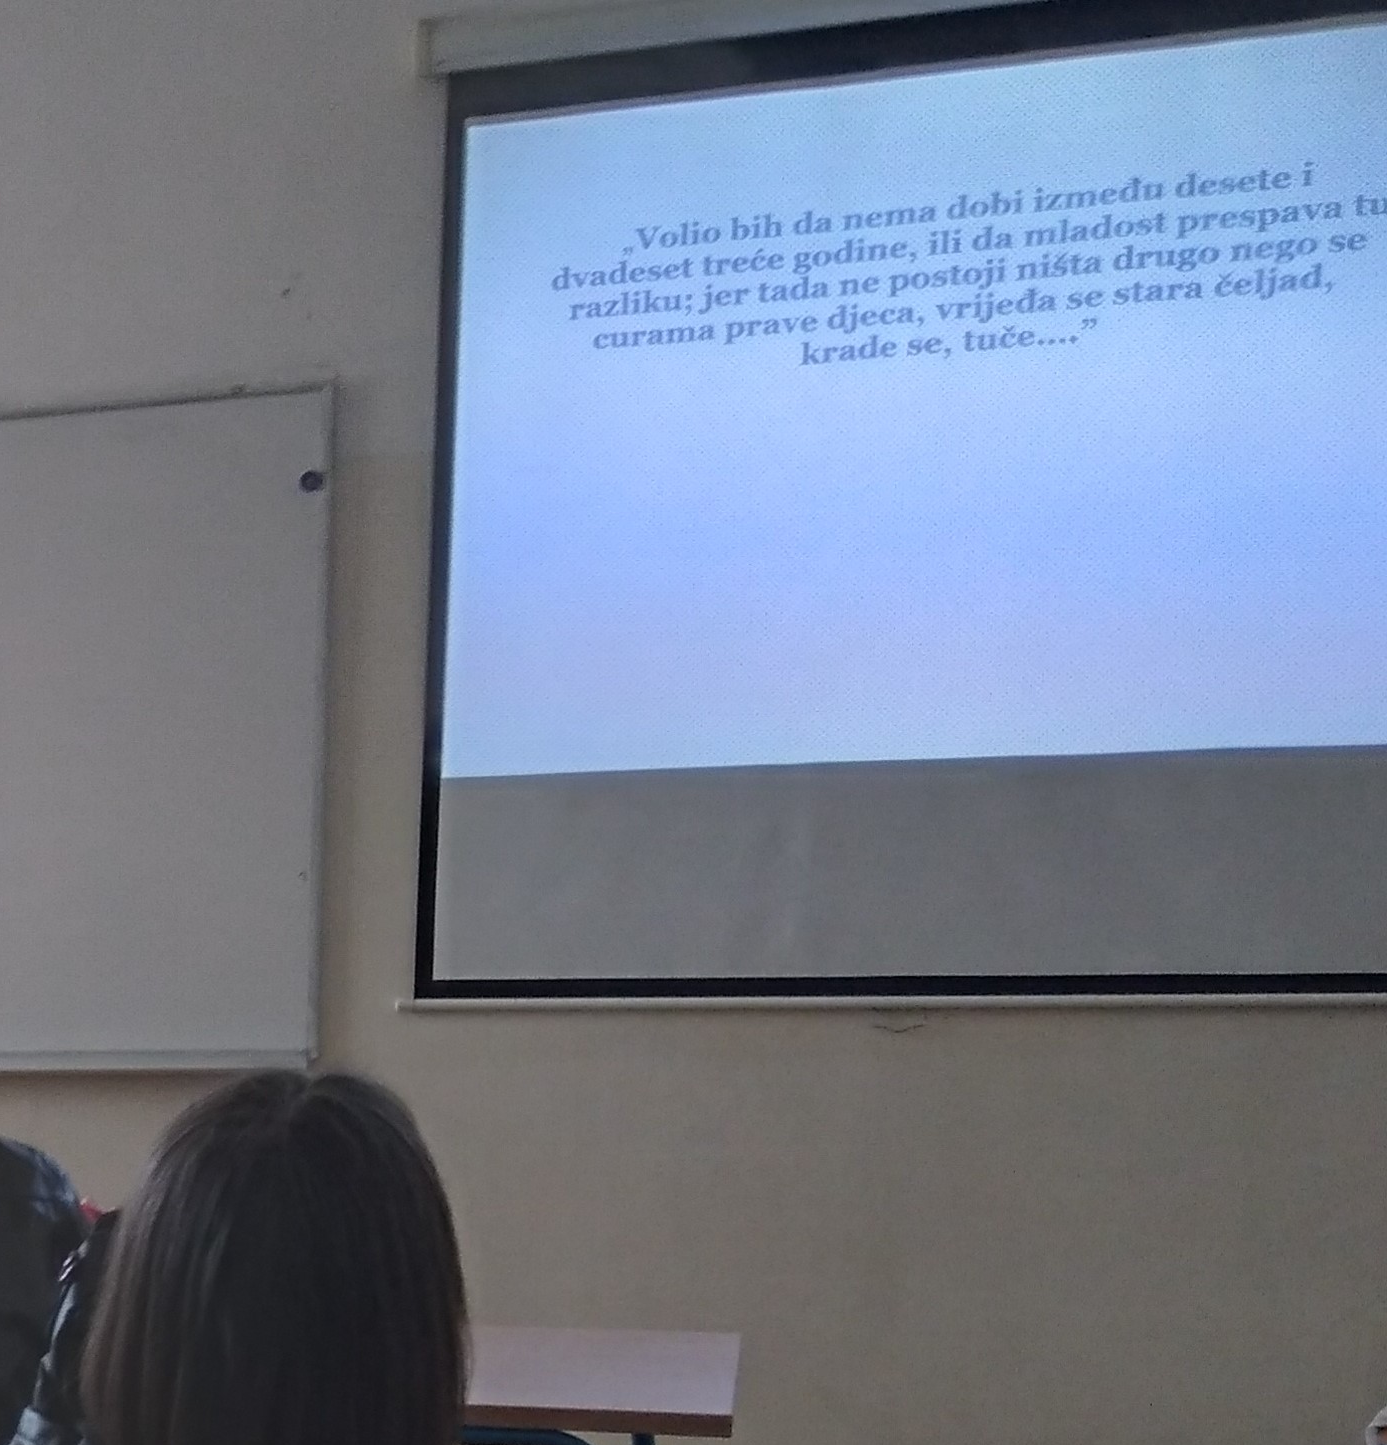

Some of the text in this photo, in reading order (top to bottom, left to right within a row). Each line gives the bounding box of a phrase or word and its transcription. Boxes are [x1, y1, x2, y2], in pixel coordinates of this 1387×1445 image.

[731, 212, 782, 241] bih
[793, 211, 832, 237] da
[843, 203, 936, 231] nema
[947, 189, 1022, 220] dobi
[1175, 167, 1291, 199] desete
[1302, 162, 1314, 187] i
[551, 258, 692, 292] dvadeset
[703, 248, 785, 278] treće
[793, 239, 918, 275] godine,
[928, 230, 962, 257] ili
[972, 225, 1013, 251] da
[1025, 212, 1167, 248] mladost
[1177, 200, 1342, 238] prespava
[569, 230, 1368, 320] razliku; jer tada ne postoji ništa drugo nego se
[593, 325, 714, 350] curama
[724, 314, 817, 344] prave
[827, 305, 925, 334] djeca,
[1066, 285, 1103, 310] se
[1113, 278, 1202, 305] stara
[1215, 263, 1334, 301] čeljad,
[801, 334, 897, 366] krade
[906, 333, 952, 359] se,
